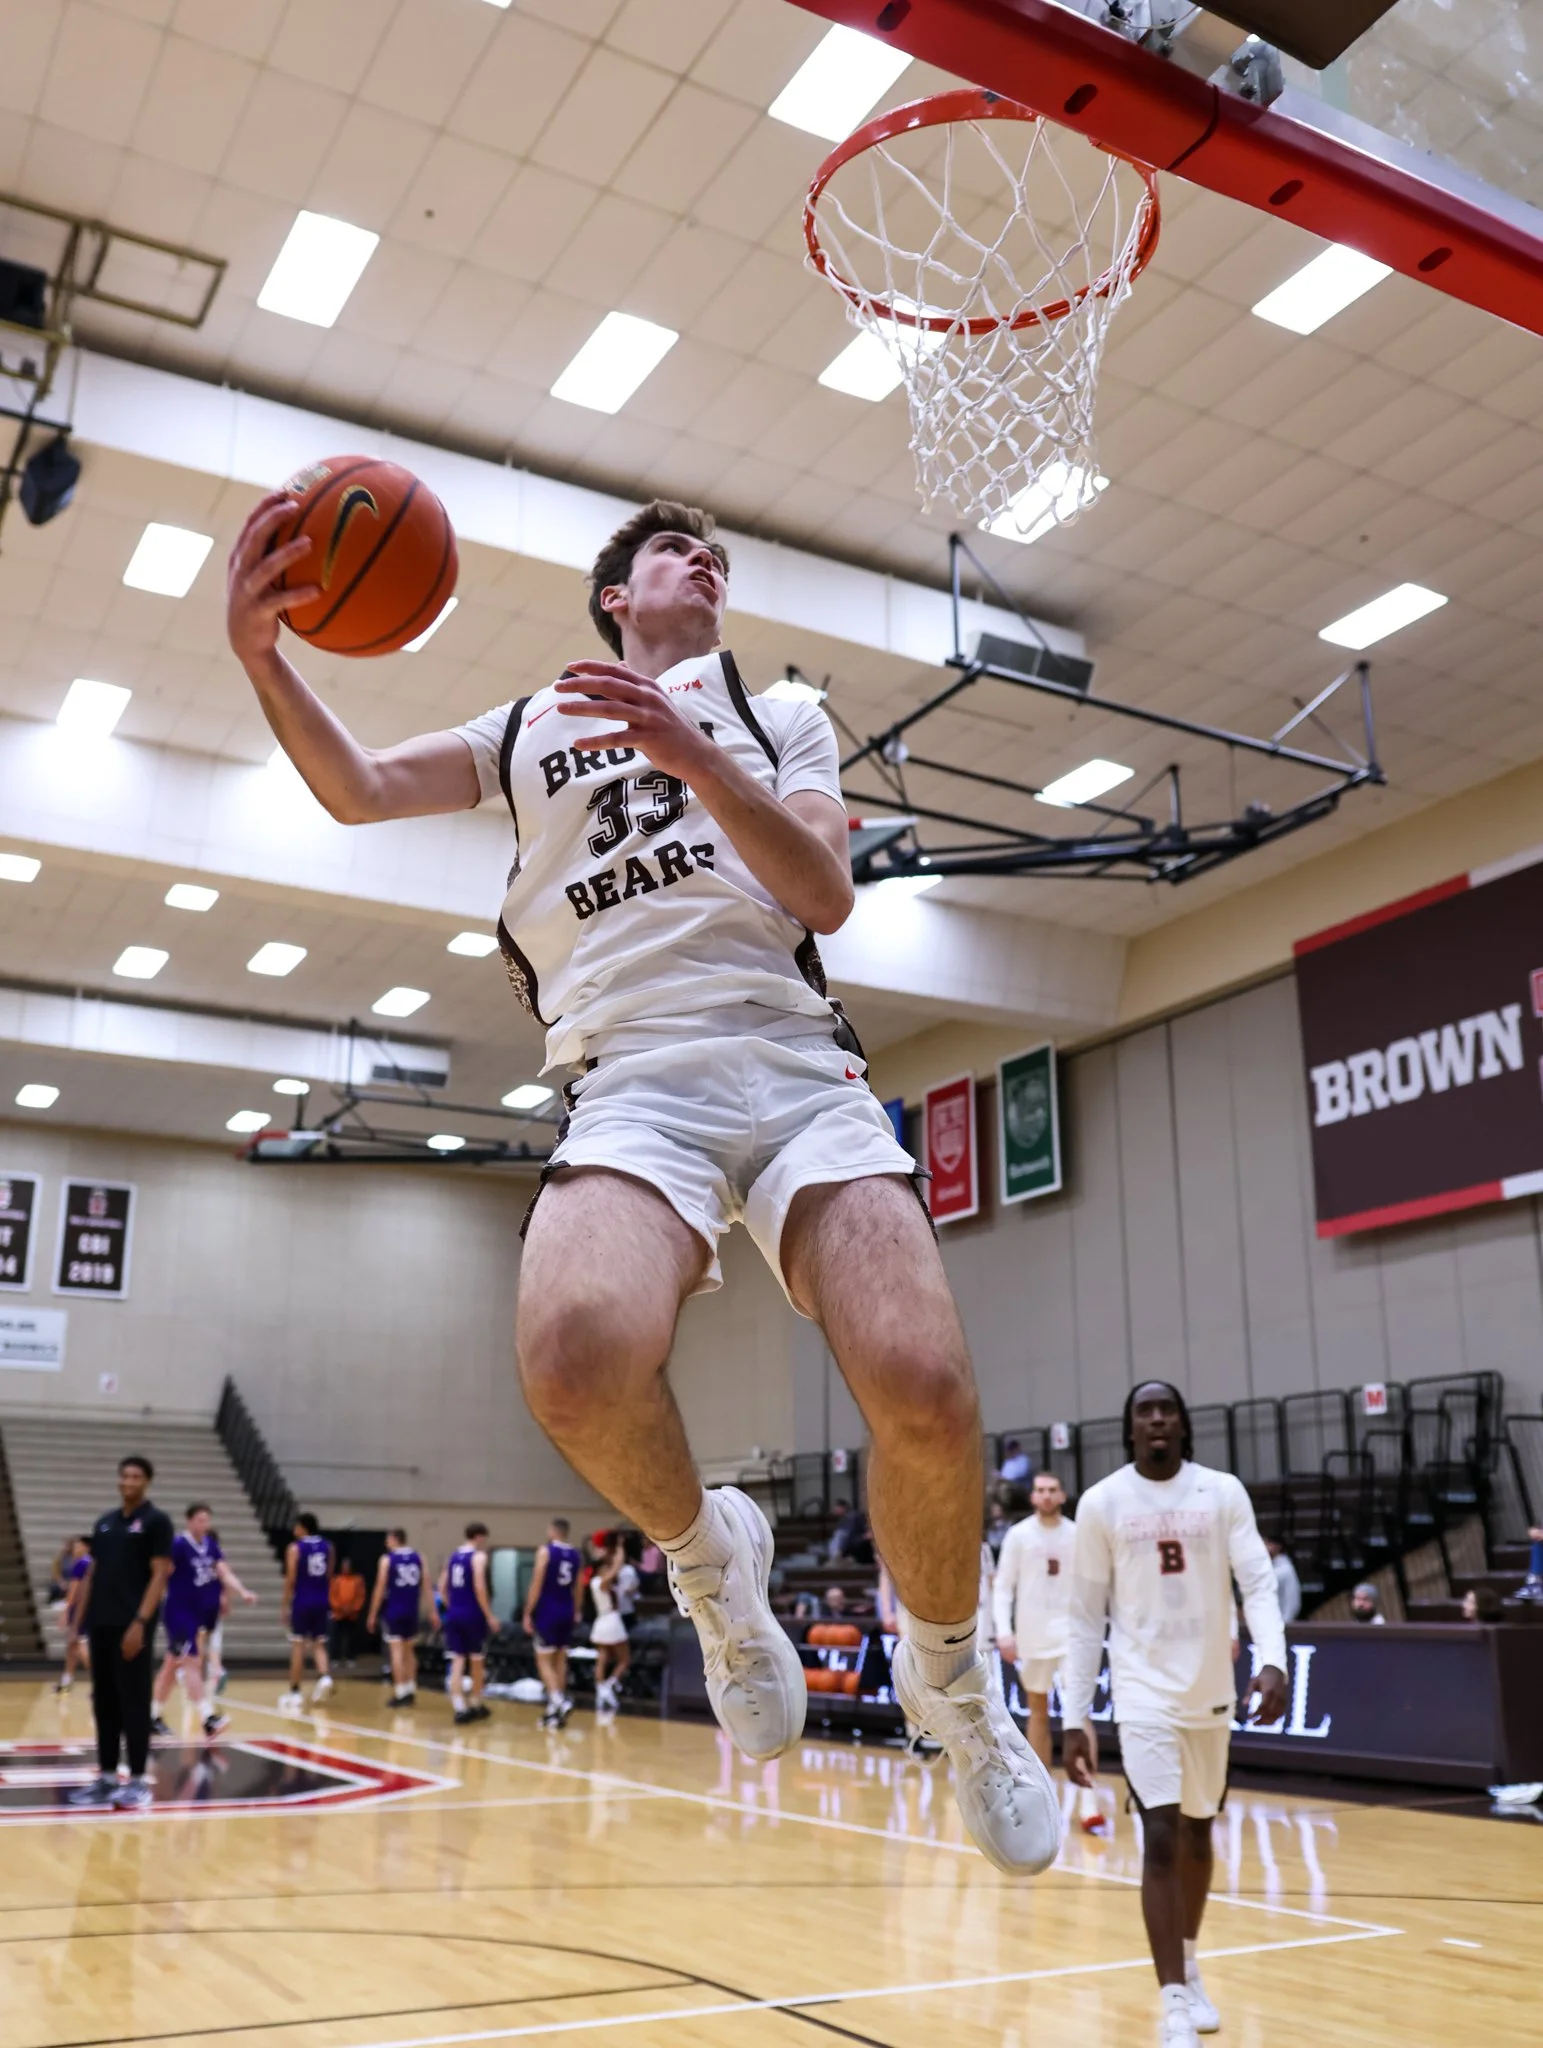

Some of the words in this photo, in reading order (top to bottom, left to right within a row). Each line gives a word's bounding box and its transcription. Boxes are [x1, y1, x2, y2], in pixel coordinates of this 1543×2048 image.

[587, 770, 689, 858] 33
[1310, 1002, 1524, 1127] BROWN
[556, 1560, 574, 1586] 5
[1157, 1539, 1186, 1575] B
